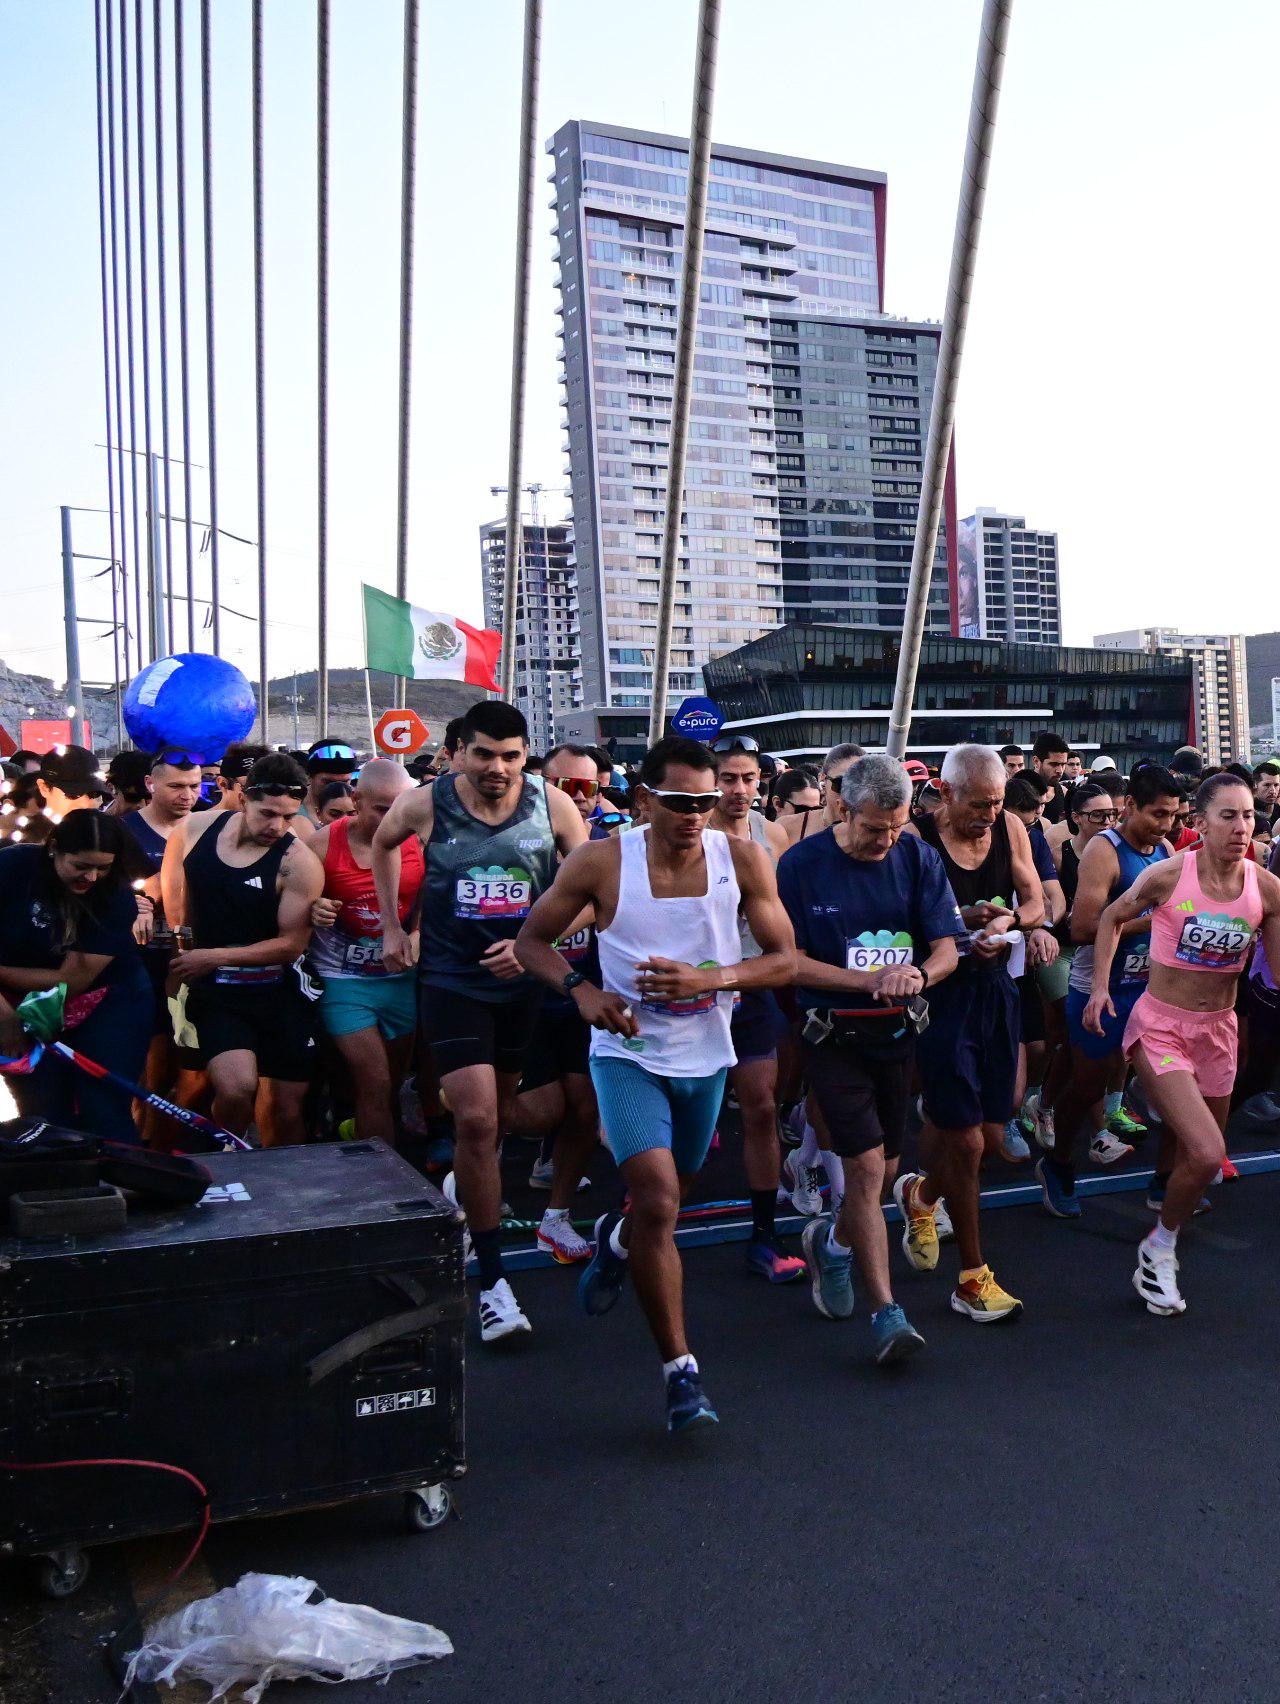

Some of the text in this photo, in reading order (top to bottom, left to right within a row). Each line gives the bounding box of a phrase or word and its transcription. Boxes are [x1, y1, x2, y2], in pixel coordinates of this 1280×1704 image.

[463, 881, 523, 899] 3136
[1188, 927, 1244, 950] 6242
[854, 949, 908, 967] 6207
[421, 1390, 431, 1402] 2
